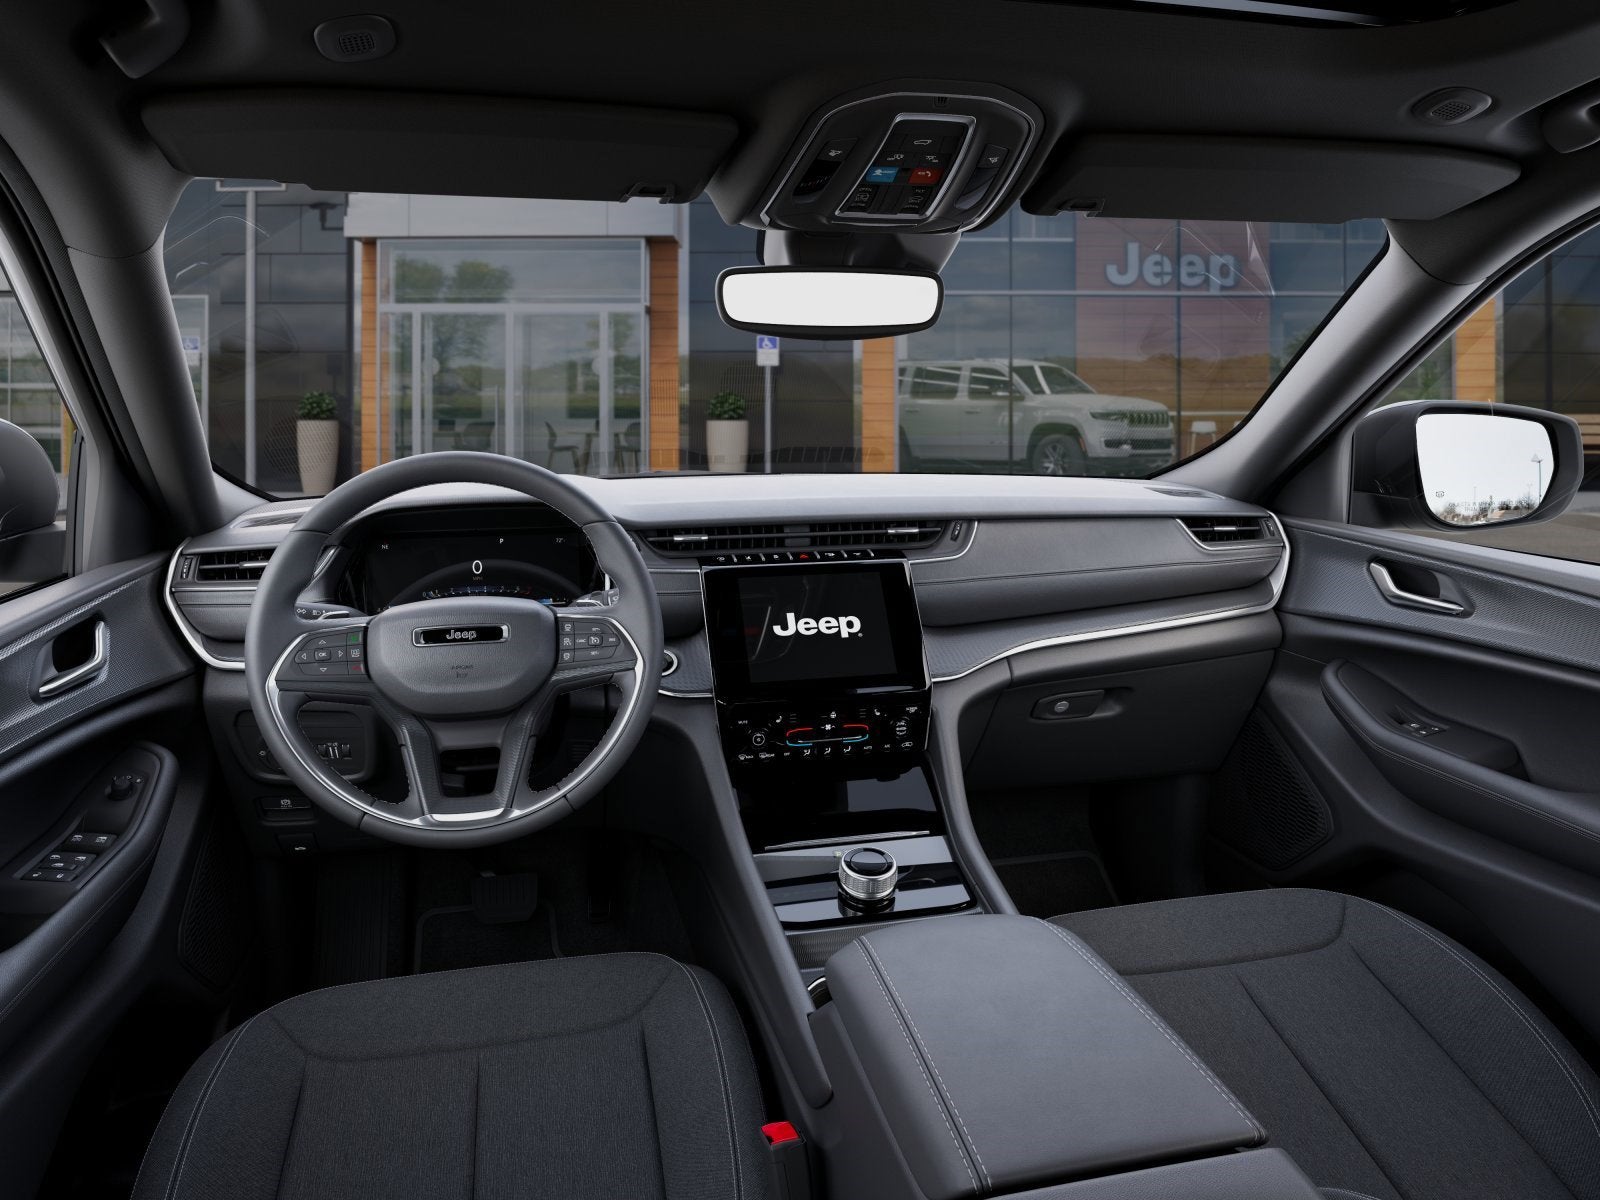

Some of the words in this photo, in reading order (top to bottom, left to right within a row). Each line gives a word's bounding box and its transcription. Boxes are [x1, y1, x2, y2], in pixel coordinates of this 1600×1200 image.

[1106, 242, 1237, 293] Jeep
[472, 560, 483, 575] 0
[445, 629, 477, 640] Jeep
[772, 612, 862, 639] Jeep
